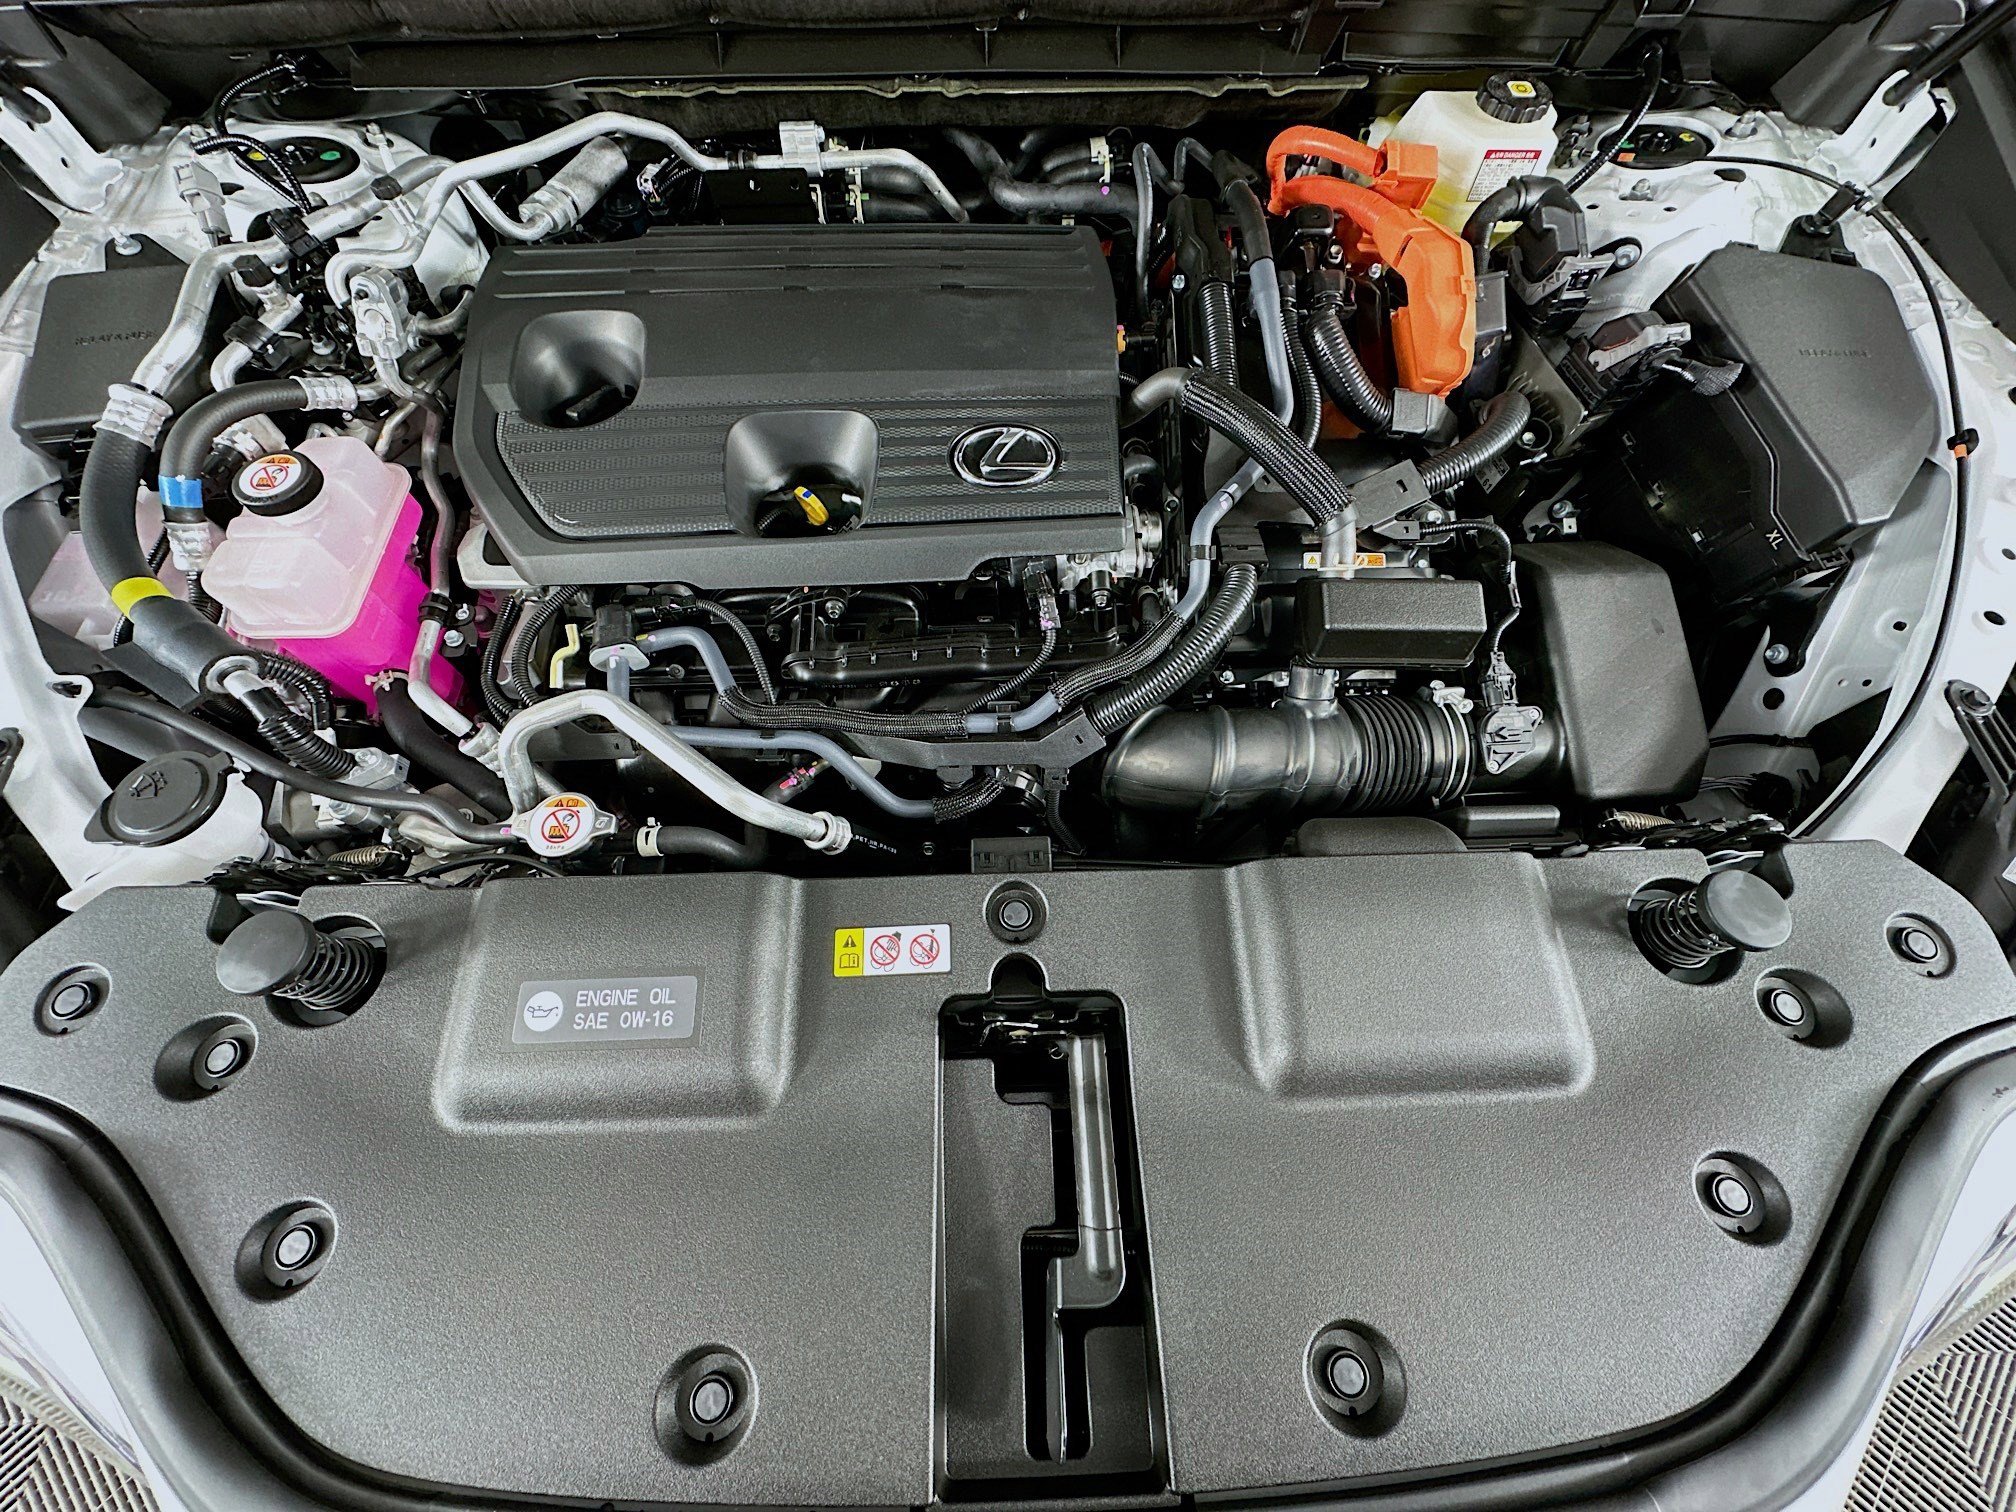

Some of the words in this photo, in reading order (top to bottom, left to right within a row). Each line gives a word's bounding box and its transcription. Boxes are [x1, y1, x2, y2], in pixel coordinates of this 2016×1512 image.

[576, 989, 639, 1007] ENGINE
[649, 988, 676, 1004] OIL
[573, 1012, 609, 1030] SAE
[620, 1010, 674, 1028] 0W-16
